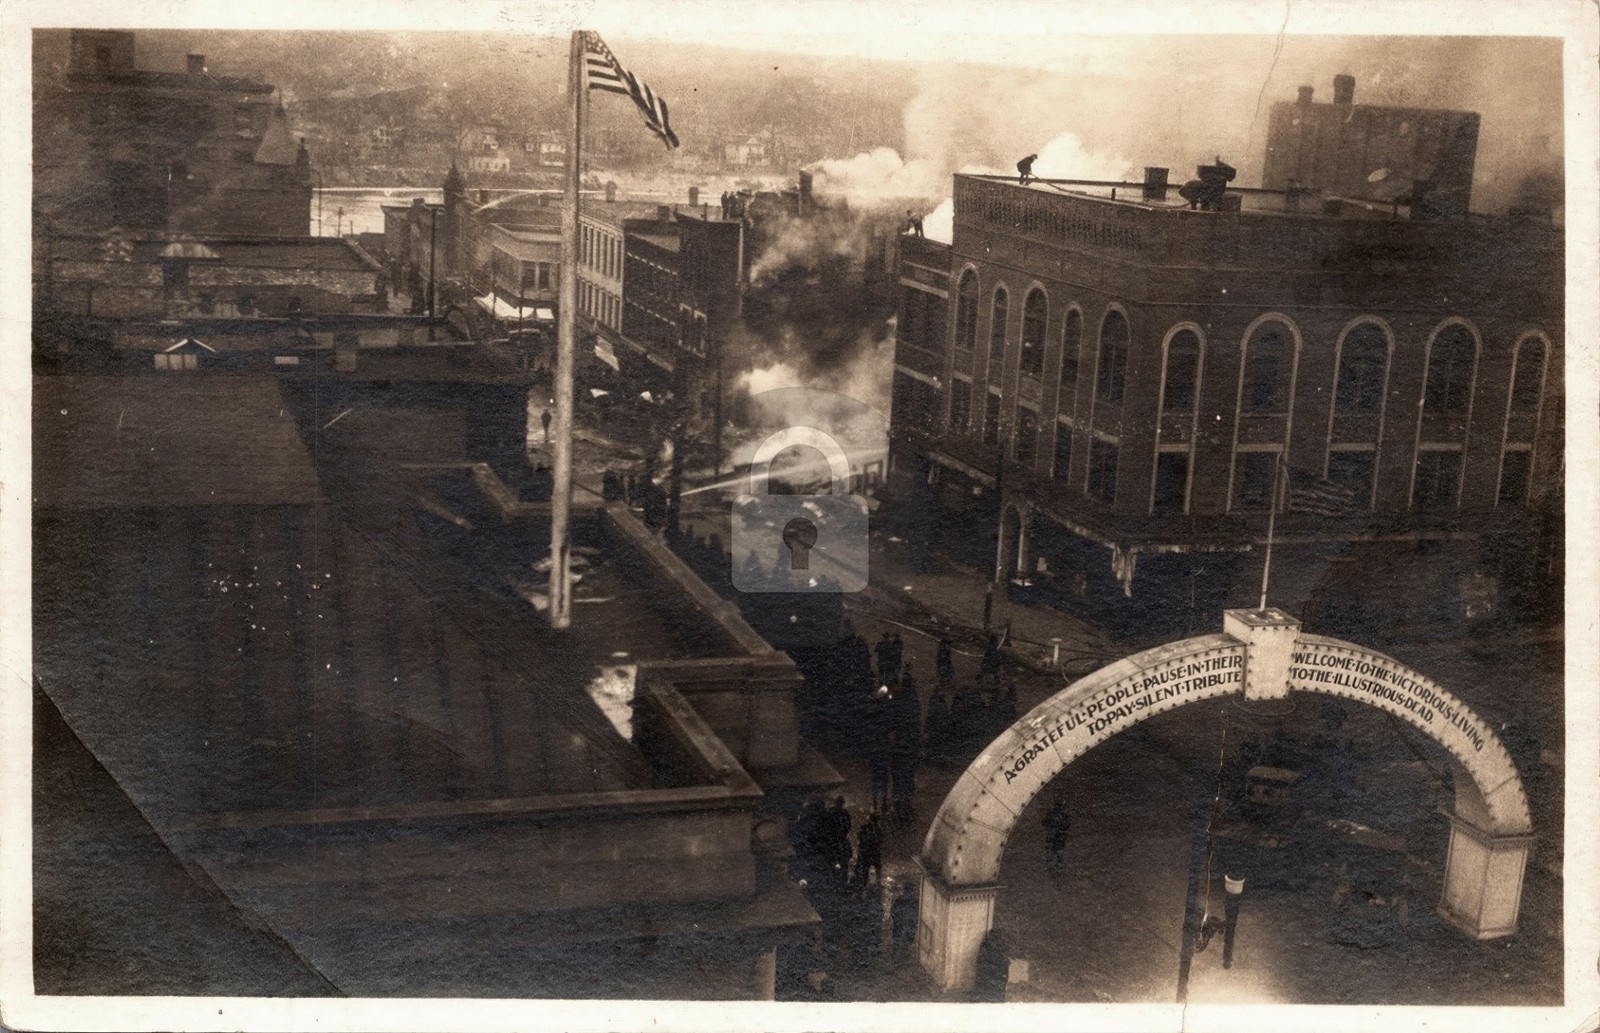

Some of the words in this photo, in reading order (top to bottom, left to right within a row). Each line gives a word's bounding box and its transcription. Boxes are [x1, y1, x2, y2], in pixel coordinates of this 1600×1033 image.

[1003, 769, 1015, 784] A
[1014, 713, 1086, 772] GRATEFUL
[1087, 683, 1140, 718] PEOPLE
[1143, 668, 1185, 690] PAUSE
[1187, 662, 1201, 676] IN
[1203, 655, 1242, 670] THEIR
[1086, 718, 1105, 736] TO
[1107, 704, 1134, 725] PAY
[1135, 685, 1182, 710] SILENT
[1184, 671, 1241, 692] TRIBUTE
[1292, 668, 1308, 680] TO
[1309, 669, 1332, 683] THE
[1334, 675, 1405, 704] ILLUSTRIOUS
[1404, 696, 1433, 724] DEAD.
[1294, 653, 1352, 669] WELCOME
[1355, 661, 1369, 675] TO
[1370, 665, 1391, 681] THE
[1391, 674, 1452, 719] VICTORIOUS
[1451, 712, 1483, 752] LIVING
